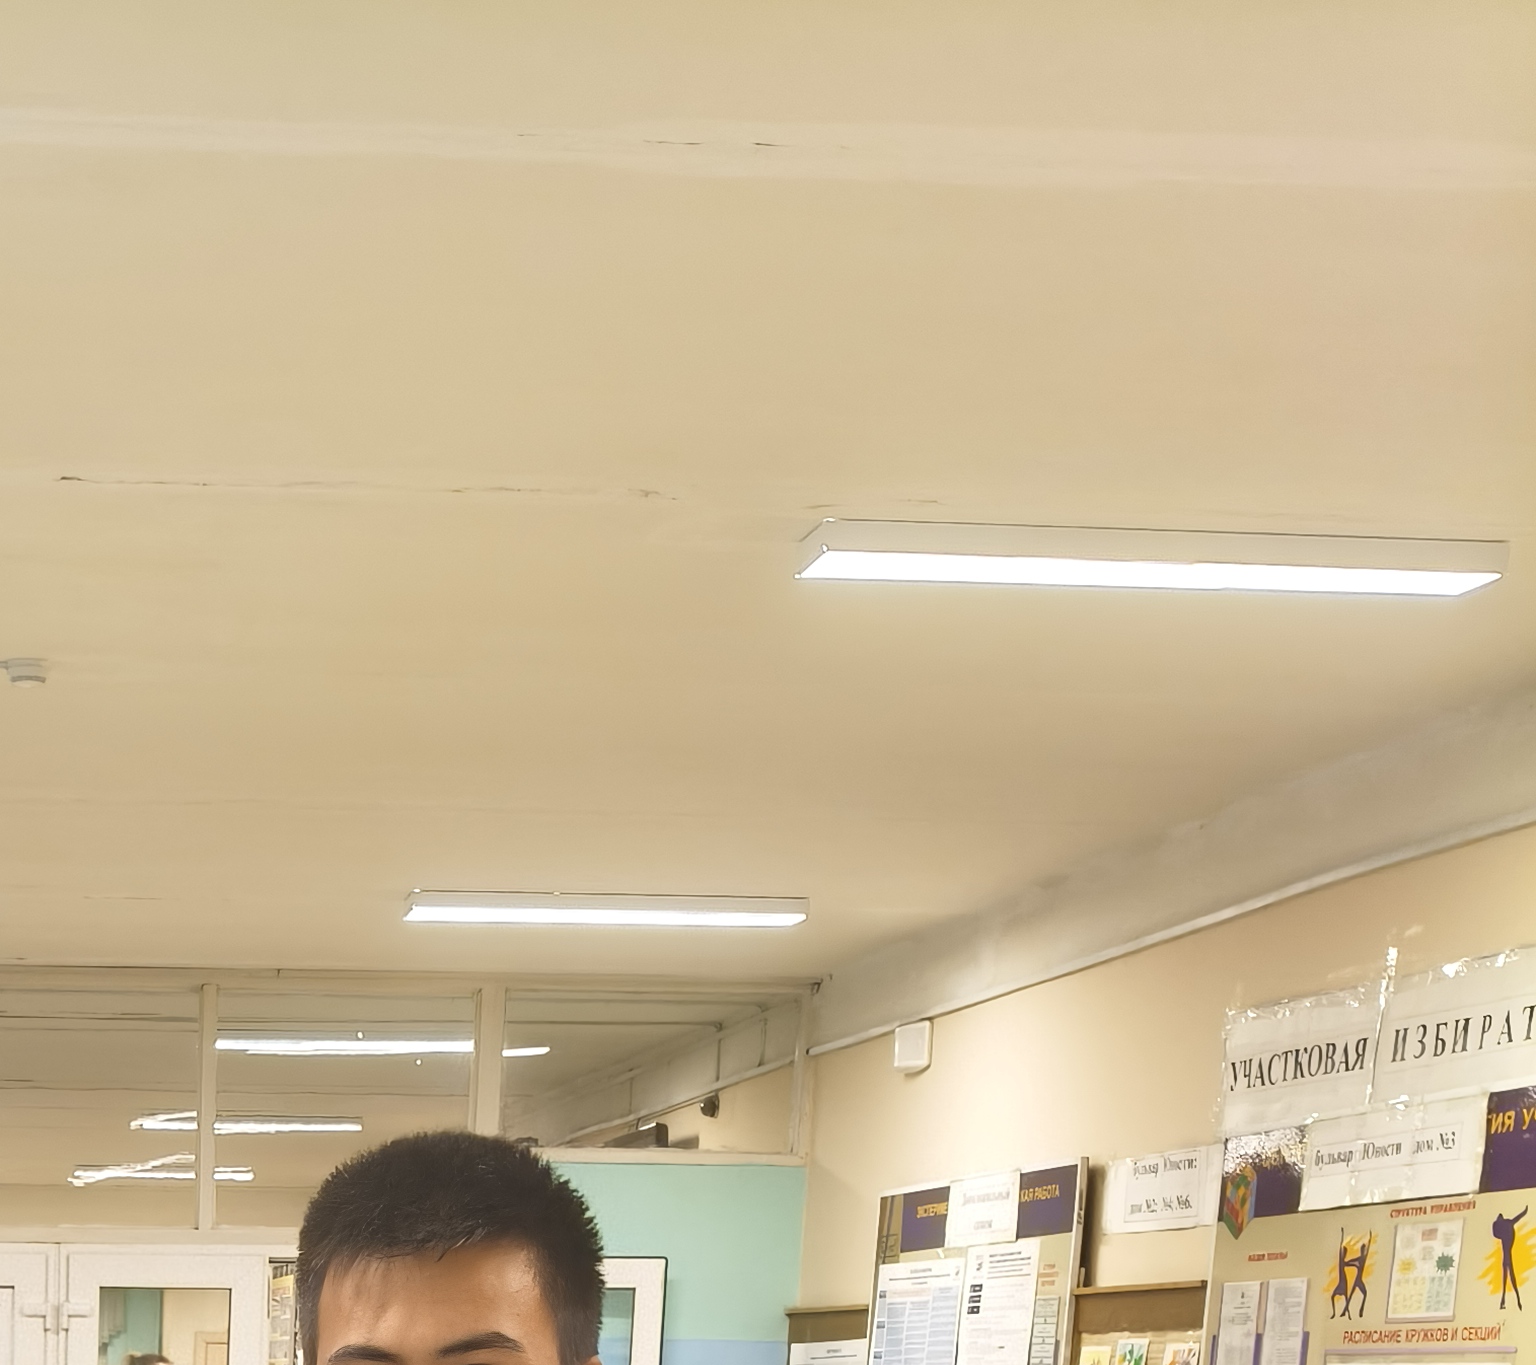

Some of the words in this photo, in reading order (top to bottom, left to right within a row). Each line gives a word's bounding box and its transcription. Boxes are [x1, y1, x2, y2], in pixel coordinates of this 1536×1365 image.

[1230, 1037, 1369, 1091] УЧАСТКОВАЯ
[1391, 1004, 1536, 1063] ИЗБИРАТ
[1488, 1110, 1515, 1134] ИЯ
[1314, 1148, 1353, 1168] бульвар
[1343, 1330, 1402, 1344] РАСПИСАНИЕ
[1405, 1328, 1449, 1343] КРУЖКОВ
[1450, 1328, 1458, 1341] И
[1461, 1323, 1501, 1341] СЕКЦИЙ
